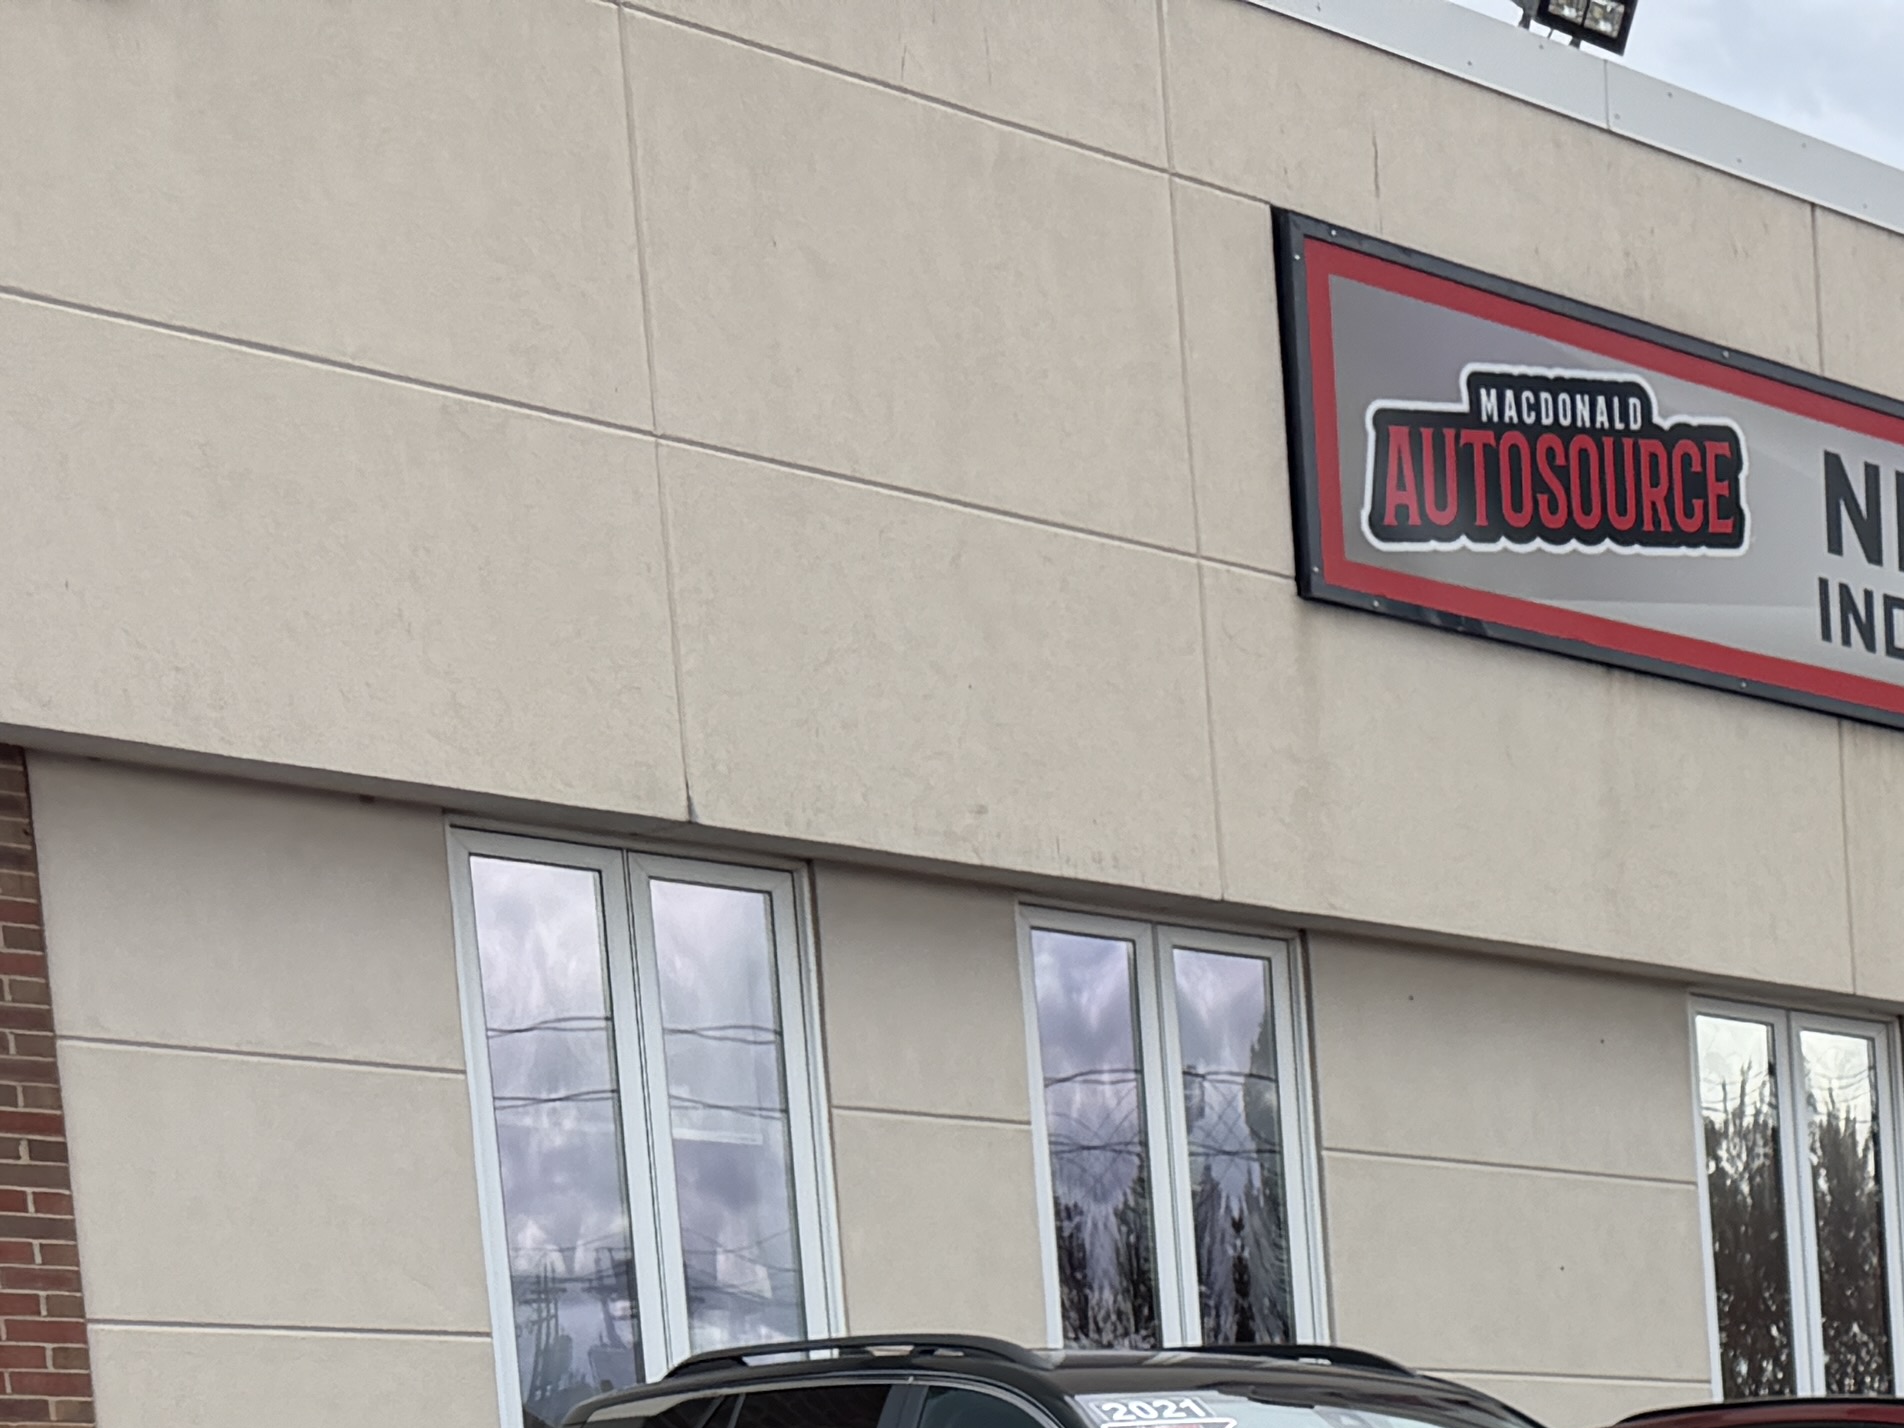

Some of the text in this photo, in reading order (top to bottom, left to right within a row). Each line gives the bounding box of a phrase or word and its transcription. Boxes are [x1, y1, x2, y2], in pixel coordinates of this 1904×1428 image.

[1480, 388, 1642, 430] MACDONALD
[1383, 425, 1737, 535] AUTOSOURCE
[1102, 1398, 1206, 1421] 2021
